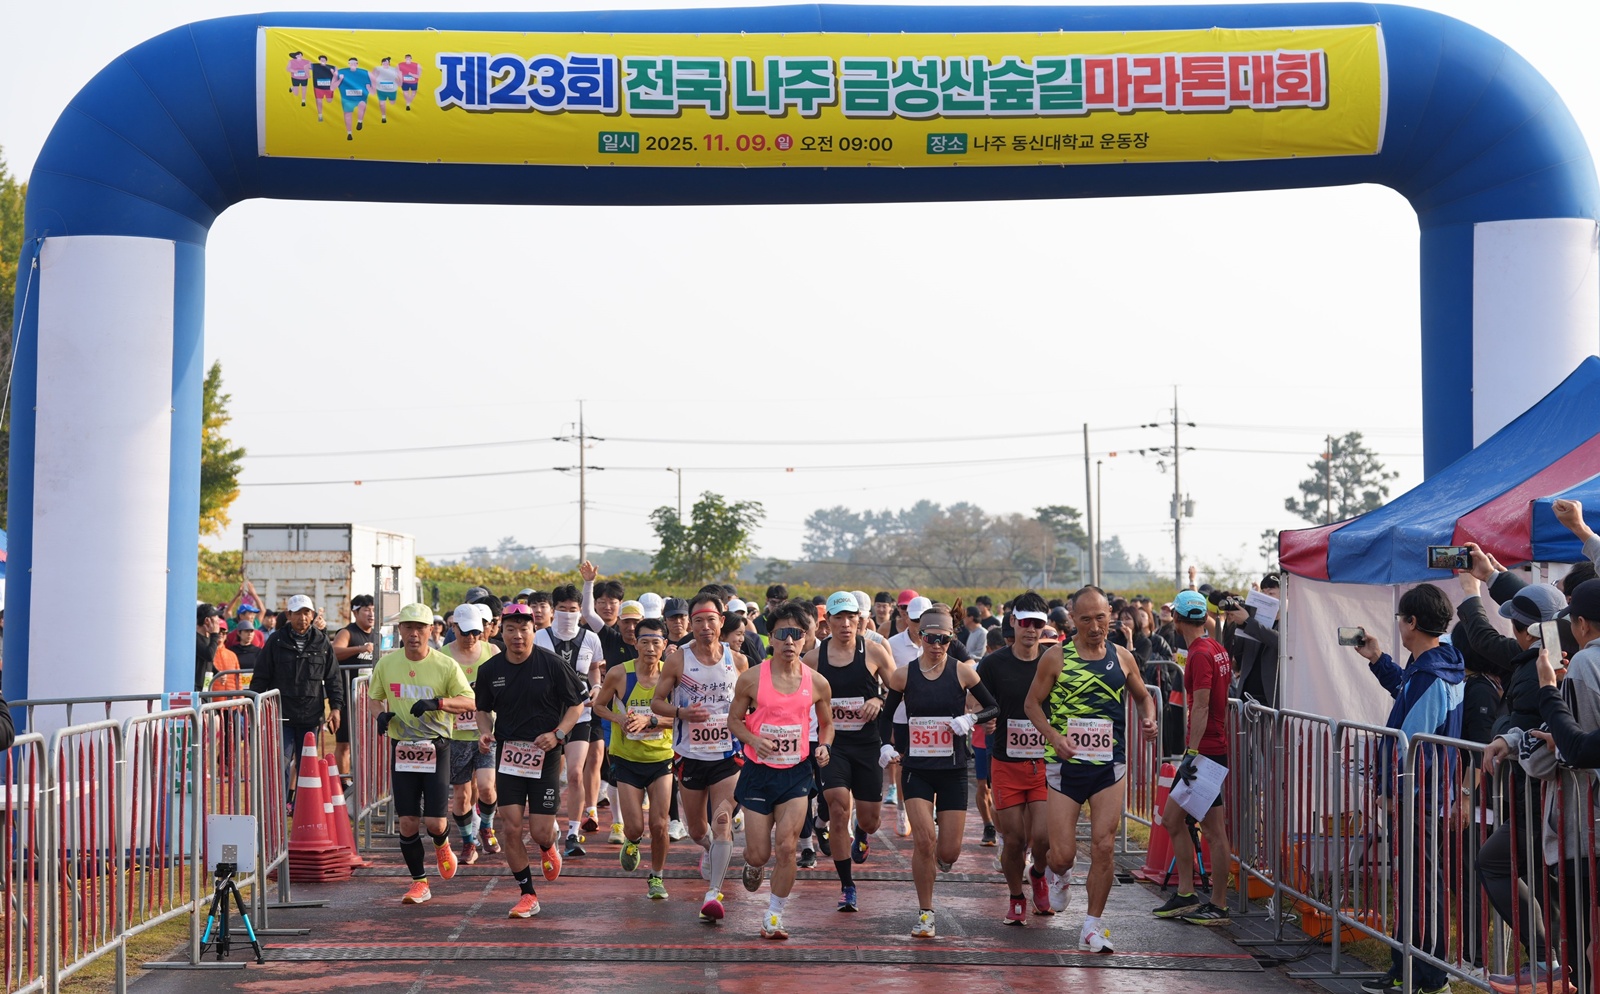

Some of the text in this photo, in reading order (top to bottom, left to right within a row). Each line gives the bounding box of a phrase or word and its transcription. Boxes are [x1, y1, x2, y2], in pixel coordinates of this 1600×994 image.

[438, 55, 615, 109] 제23회
[625, 58, 723, 112] 전국
[735, 59, 831, 111] 나주
[602, 134, 636, 152] 일시
[645, 136, 698, 151] 2025.
[800, 135, 833, 152] 오전
[838, 136, 893, 151] 09:00
[930, 132, 1150, 152] 장소 나주 동신대학교 운동장
[834, 597, 851, 605] HOKA
[692, 727, 729, 741] 3005
[912, 731, 951, 745] 3510
[1010, 733, 1046, 746] 3030
[1070, 733, 1111, 748] 3036
[398, 750, 433, 761] 3027
[504, 749, 541, 767] 3025
